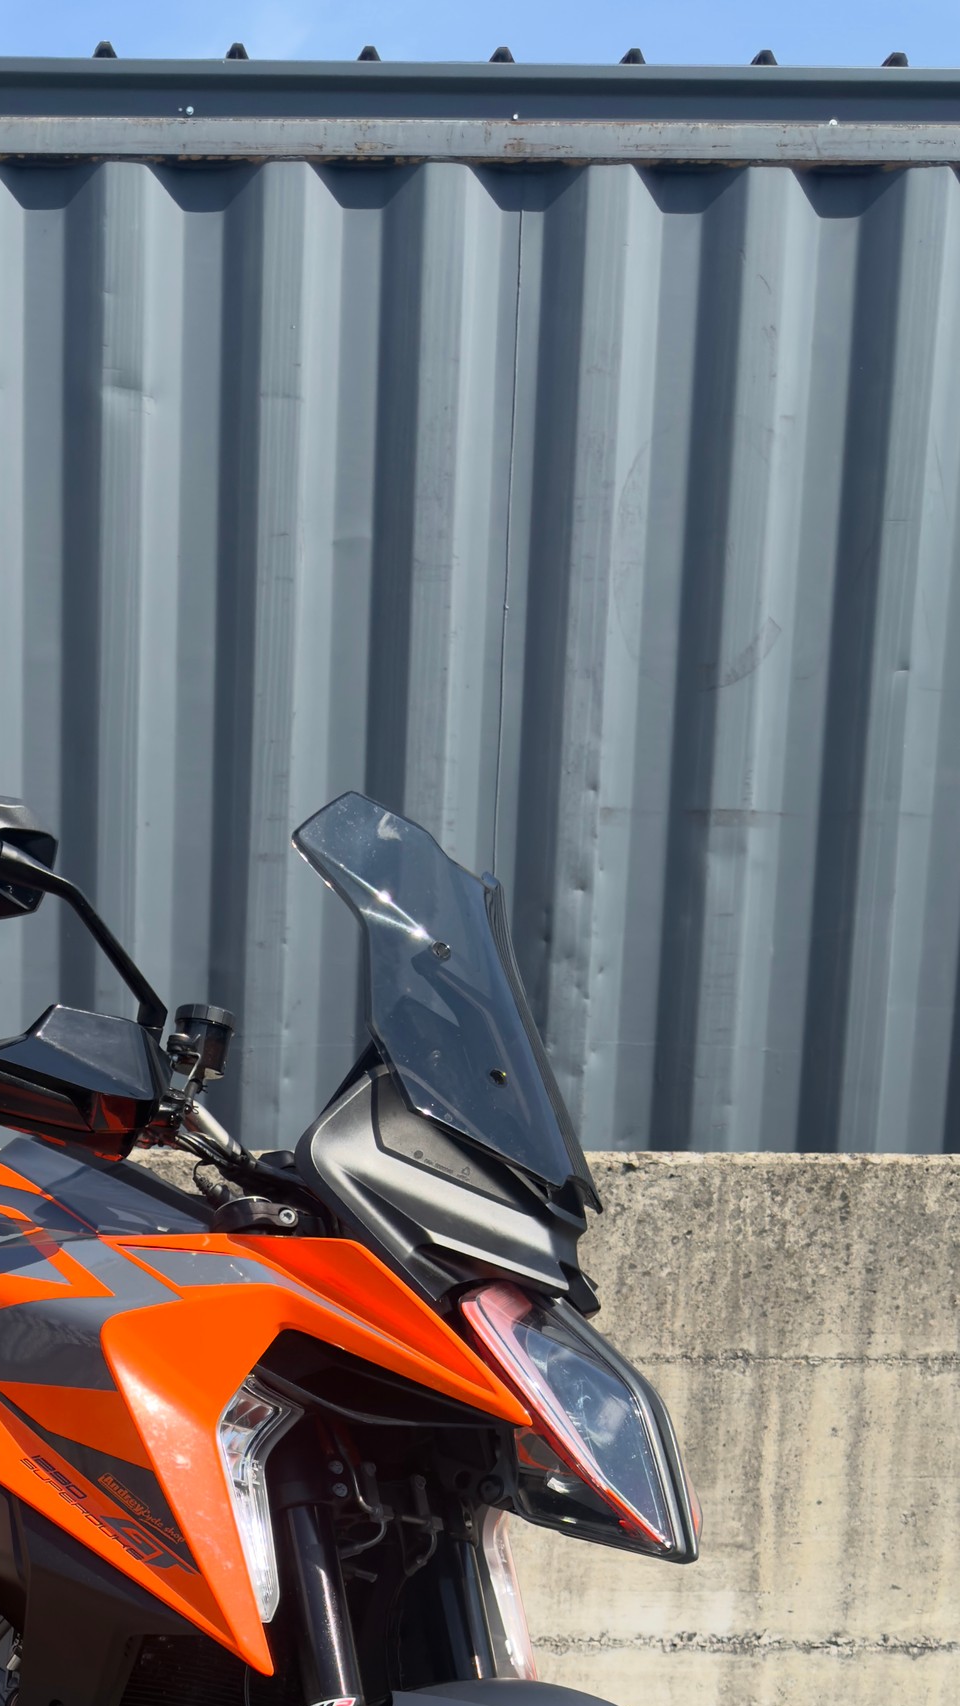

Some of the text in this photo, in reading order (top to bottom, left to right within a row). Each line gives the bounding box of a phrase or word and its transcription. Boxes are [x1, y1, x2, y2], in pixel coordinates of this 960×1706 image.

[31, 1455, 88, 1500] 1290
[102, 1476, 146, 1516] Andrey
[99, 1515, 198, 1574] GT
